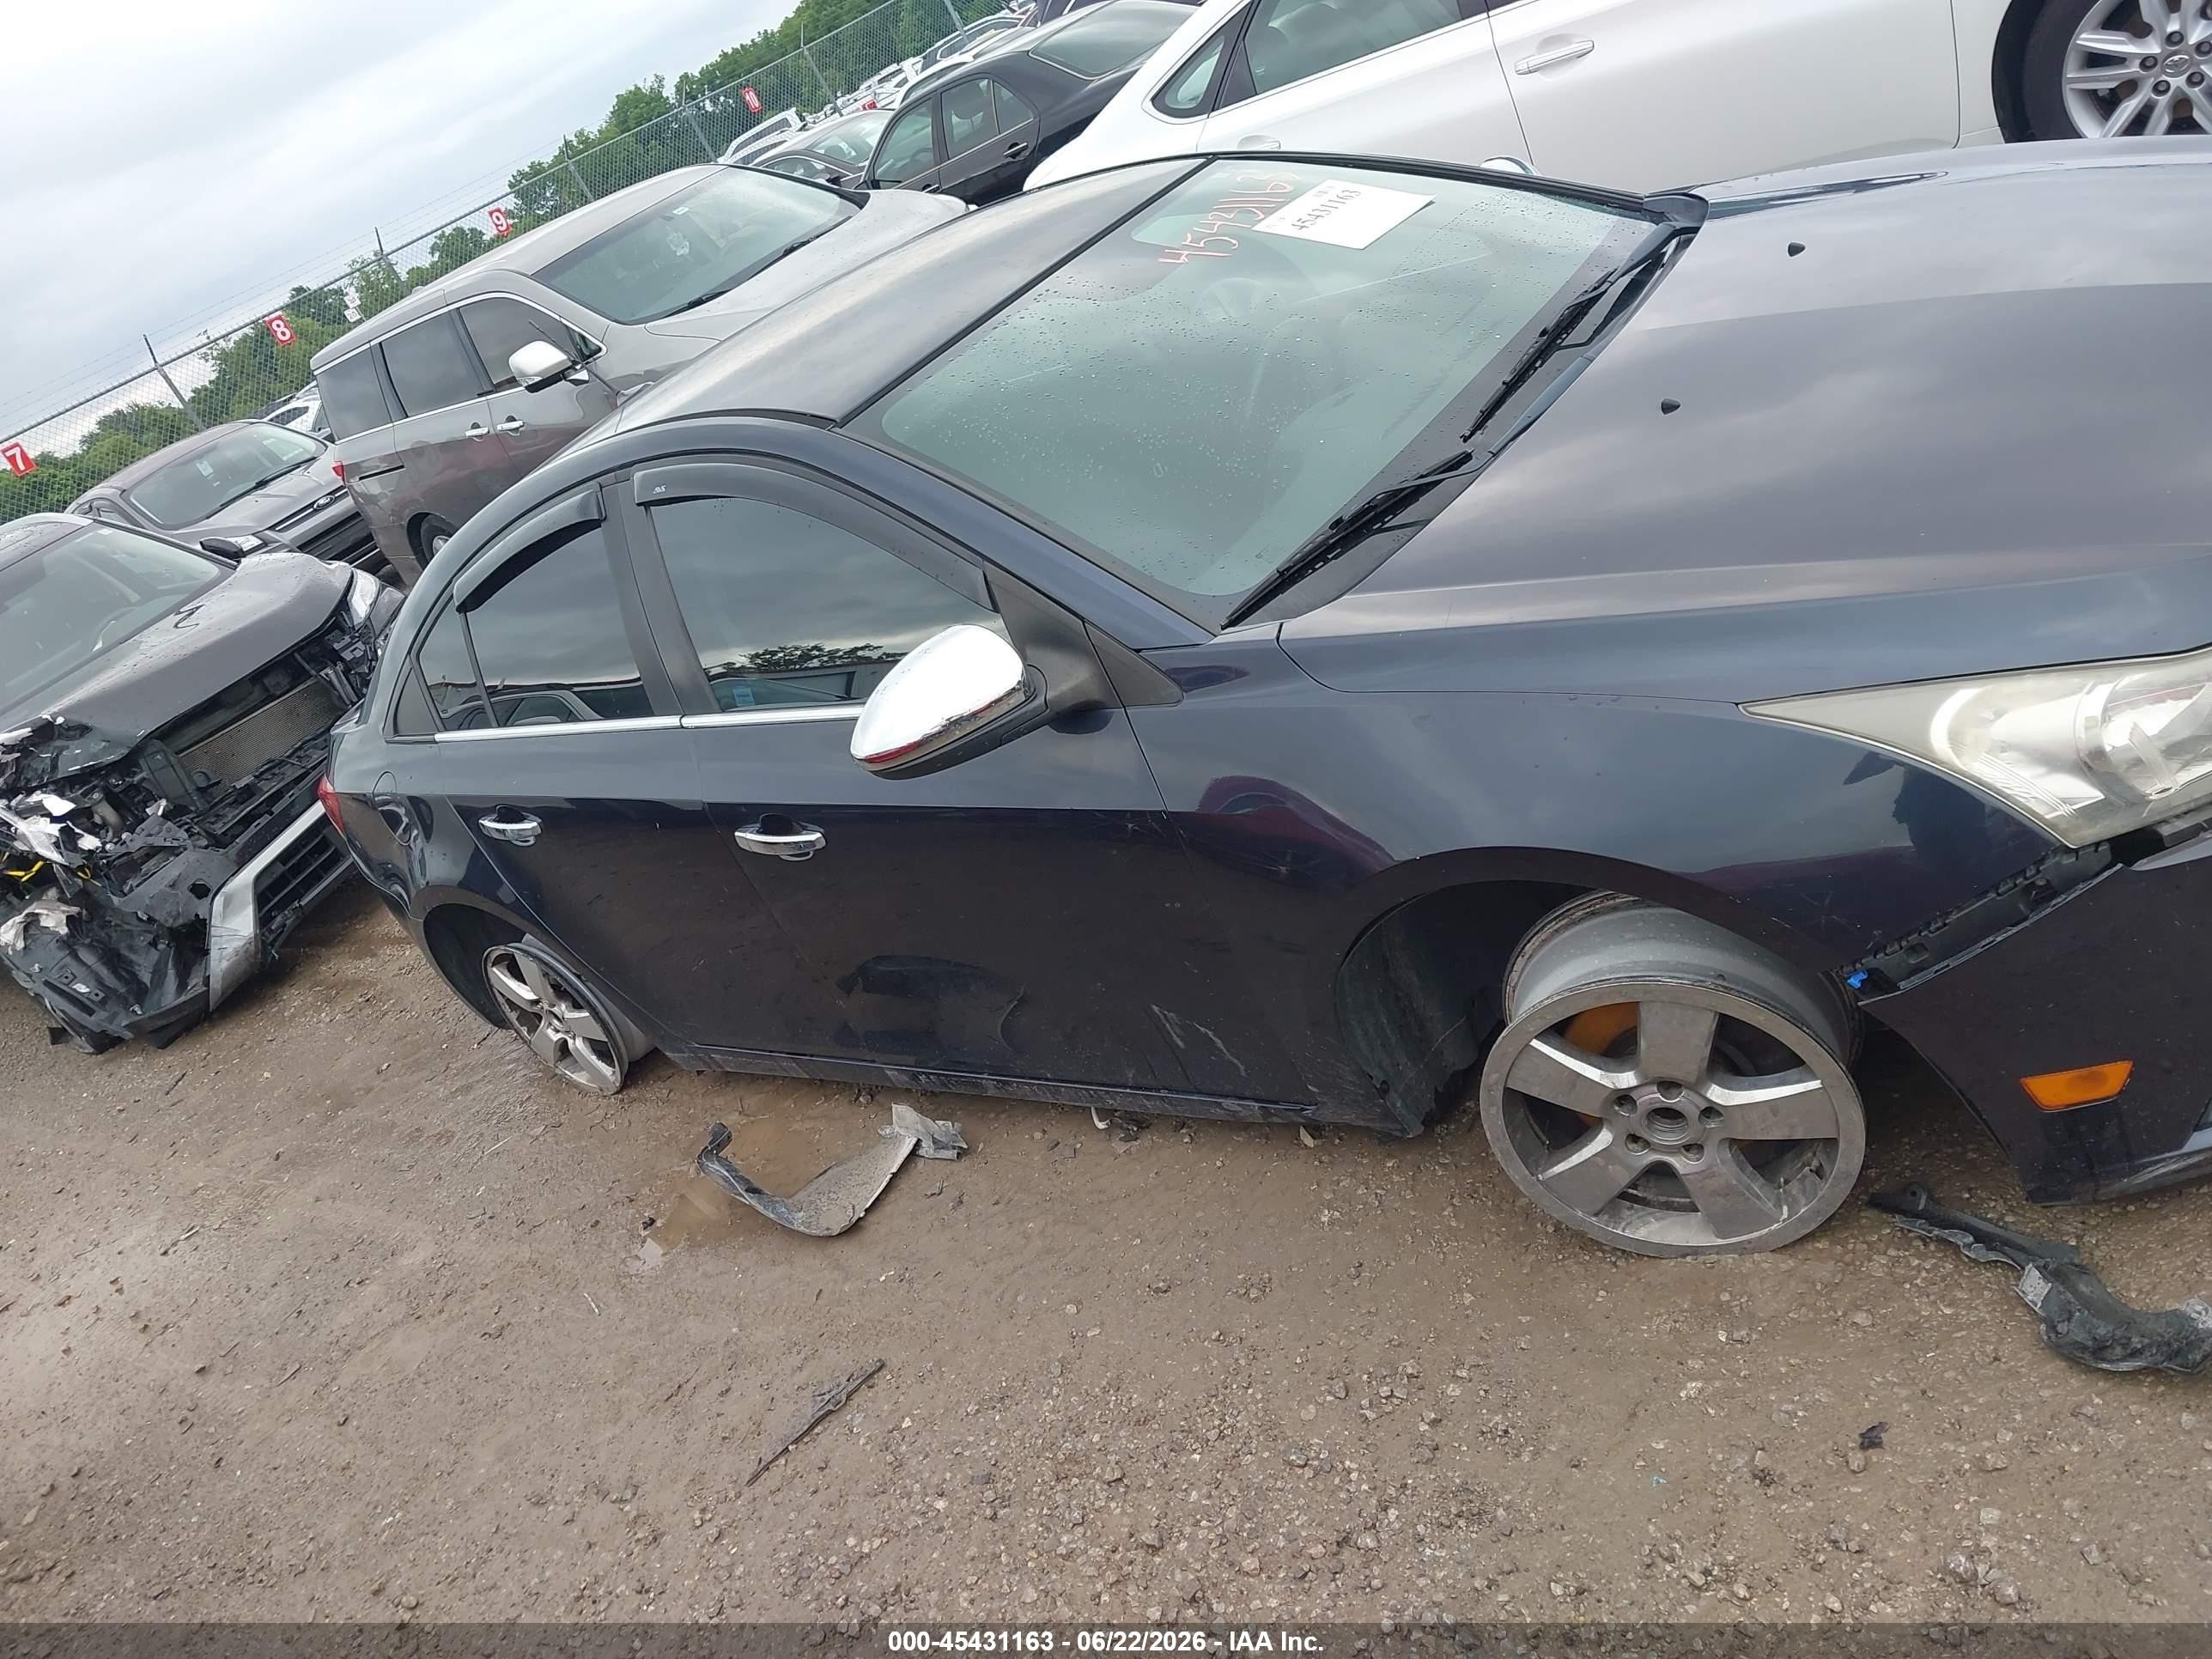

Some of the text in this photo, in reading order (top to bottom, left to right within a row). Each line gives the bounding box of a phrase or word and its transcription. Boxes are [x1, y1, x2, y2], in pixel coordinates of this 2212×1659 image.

[744, 90, 760, 110] 10
[491, 211, 507, 232] 9
[1157, 169, 1299, 264] 45431163
[1291, 189, 1361, 231] 45431163
[271, 319, 291, 341] 8
[4, 446, 27, 471] 7
